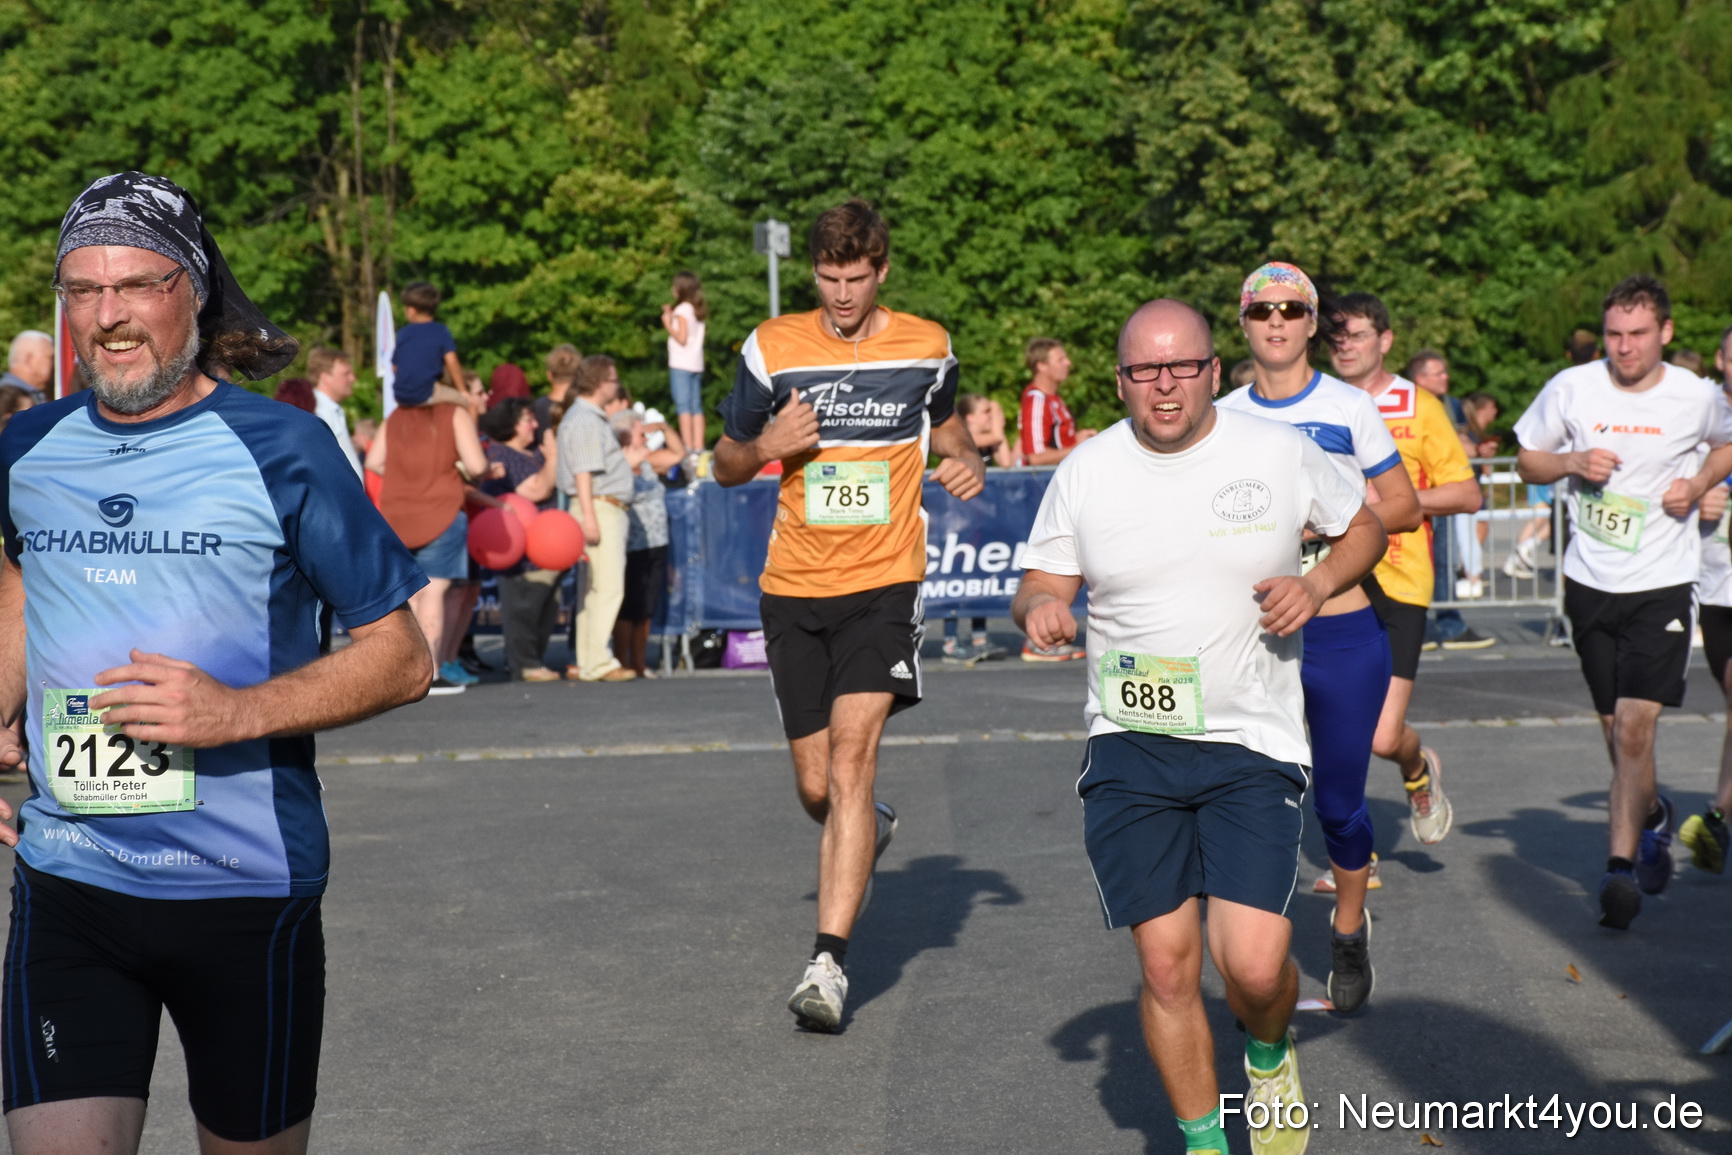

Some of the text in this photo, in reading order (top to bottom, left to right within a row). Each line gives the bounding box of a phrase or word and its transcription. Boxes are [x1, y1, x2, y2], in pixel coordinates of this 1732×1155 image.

[821, 418, 899, 427] AUTOMOBILE
[822, 485, 870, 507] 785
[1220, 505, 1266, 521] NATURKOST
[1586, 503, 1631, 535] 1151
[24, 529, 222, 556] SCHABMÜLLER
[84, 567, 137, 585] TEAM
[921, 577, 1019, 599] MOBILE
[1121, 680, 1176, 712] 688
[1118, 708, 1183, 721] Hentschel Enrico
[56, 733, 170, 778] 2123
[73, 780, 147, 792] Töllich Peter
[73, 793, 148, 802] Schabmüller GmbH
[43, 828, 240, 870] www.scabmueller.de
